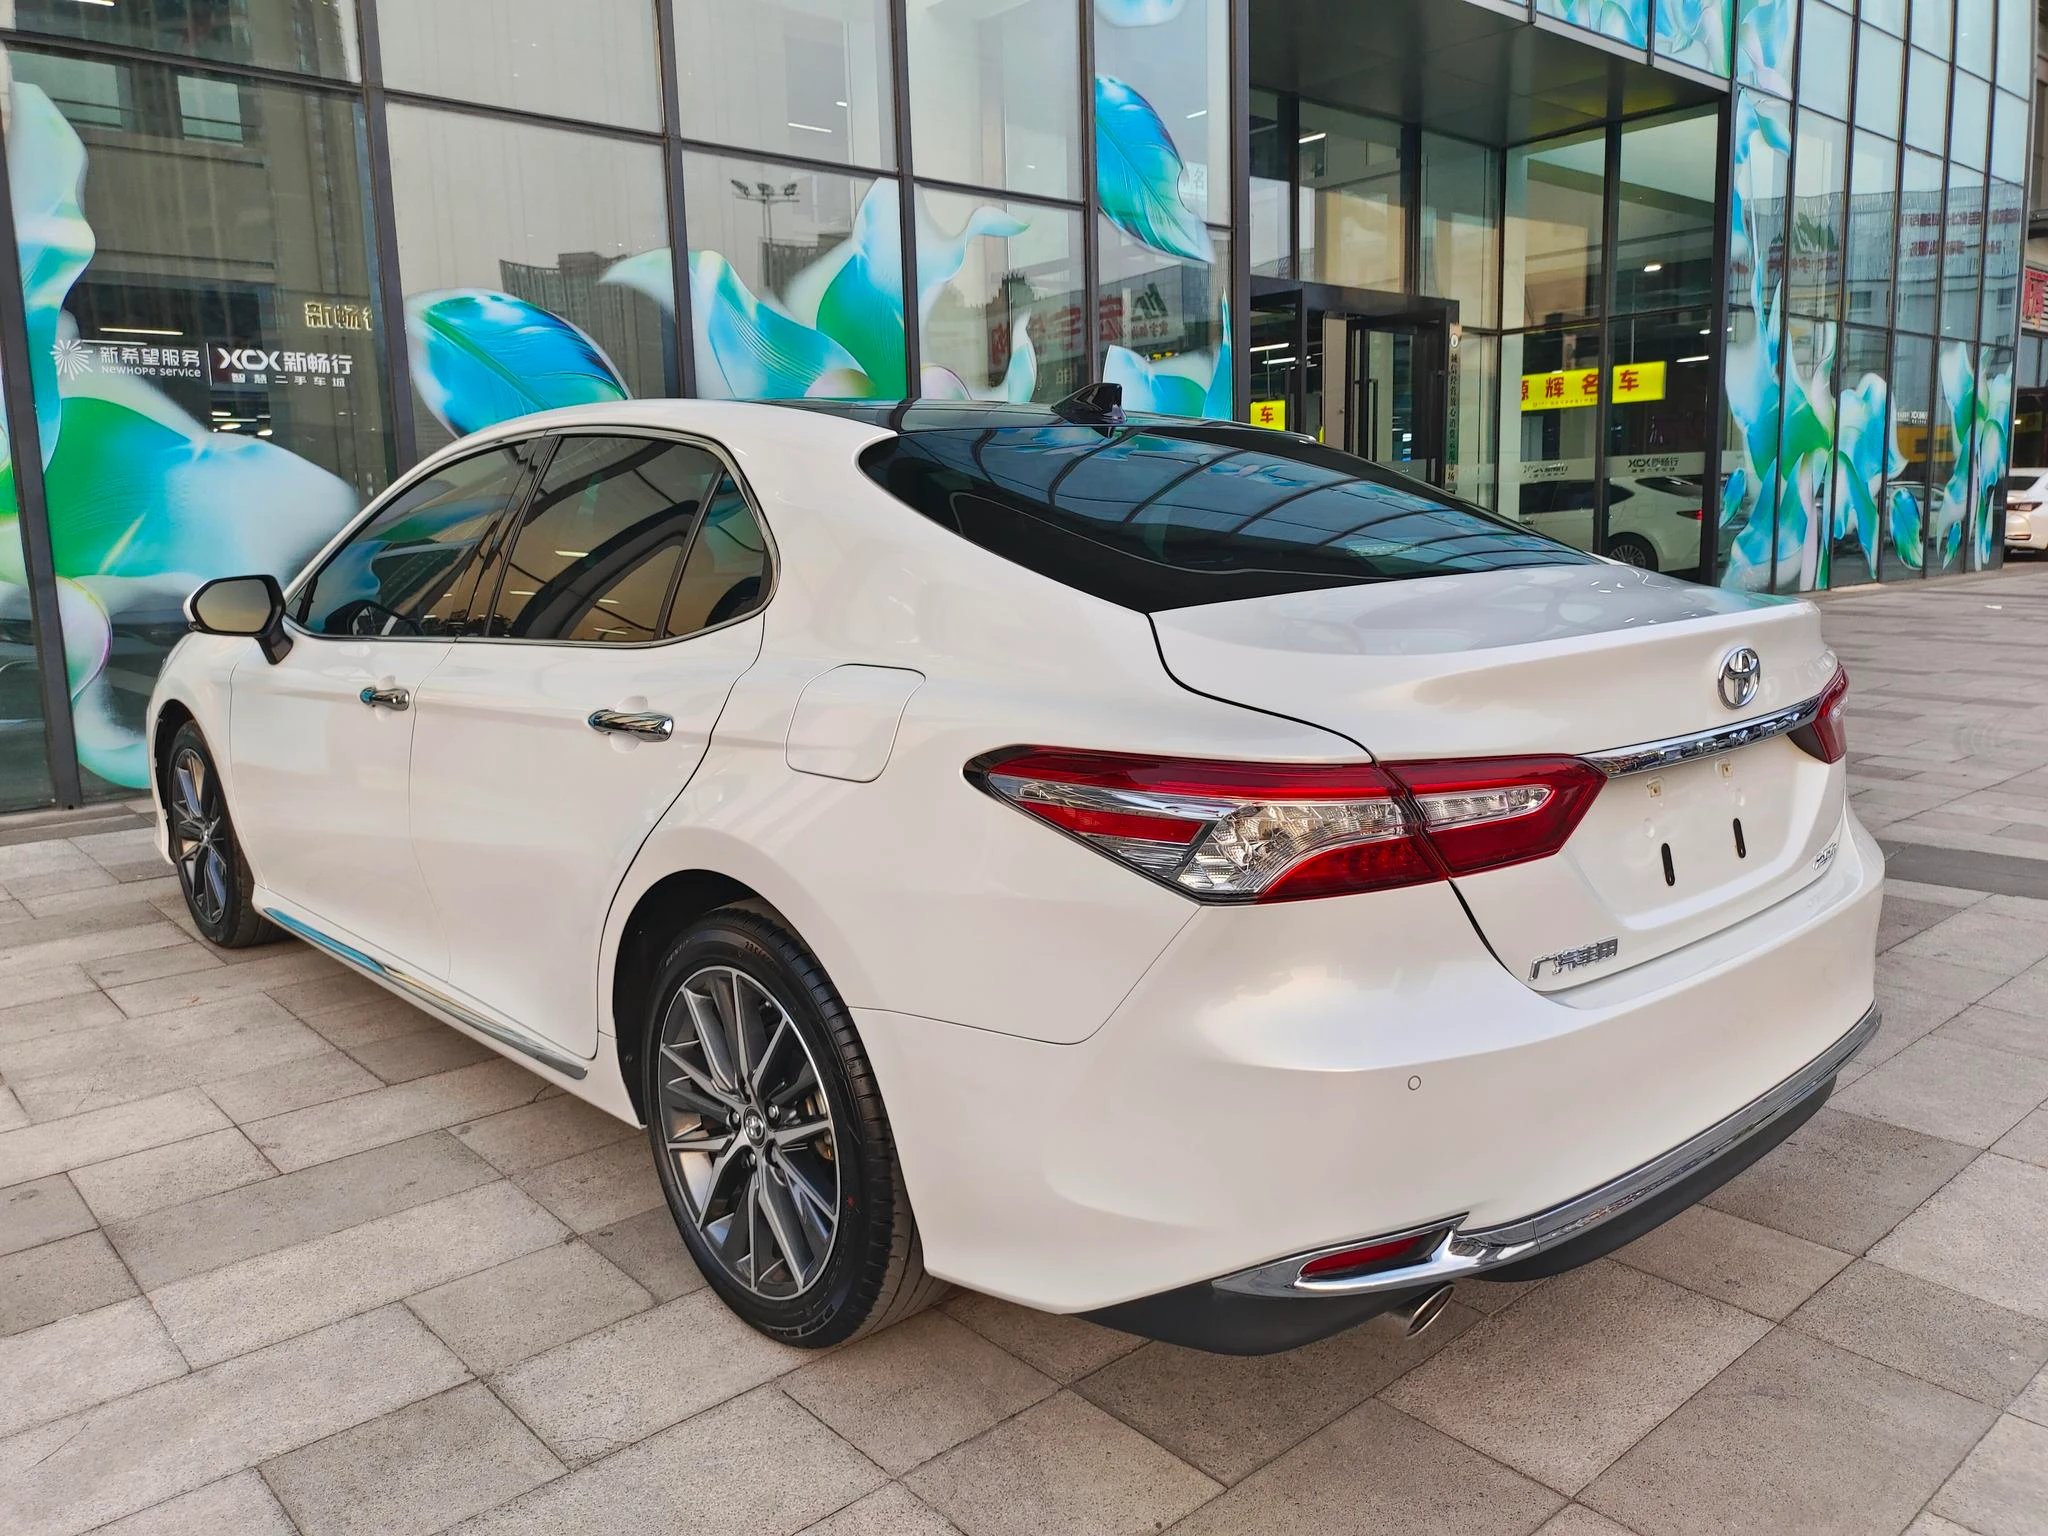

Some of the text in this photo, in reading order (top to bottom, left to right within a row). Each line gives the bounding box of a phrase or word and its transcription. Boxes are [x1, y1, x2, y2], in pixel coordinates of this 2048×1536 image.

[100, 346, 200, 367] 新希望服务
[283, 351, 353, 374] 新畅行
[1260, 406, 1274, 424] 车
